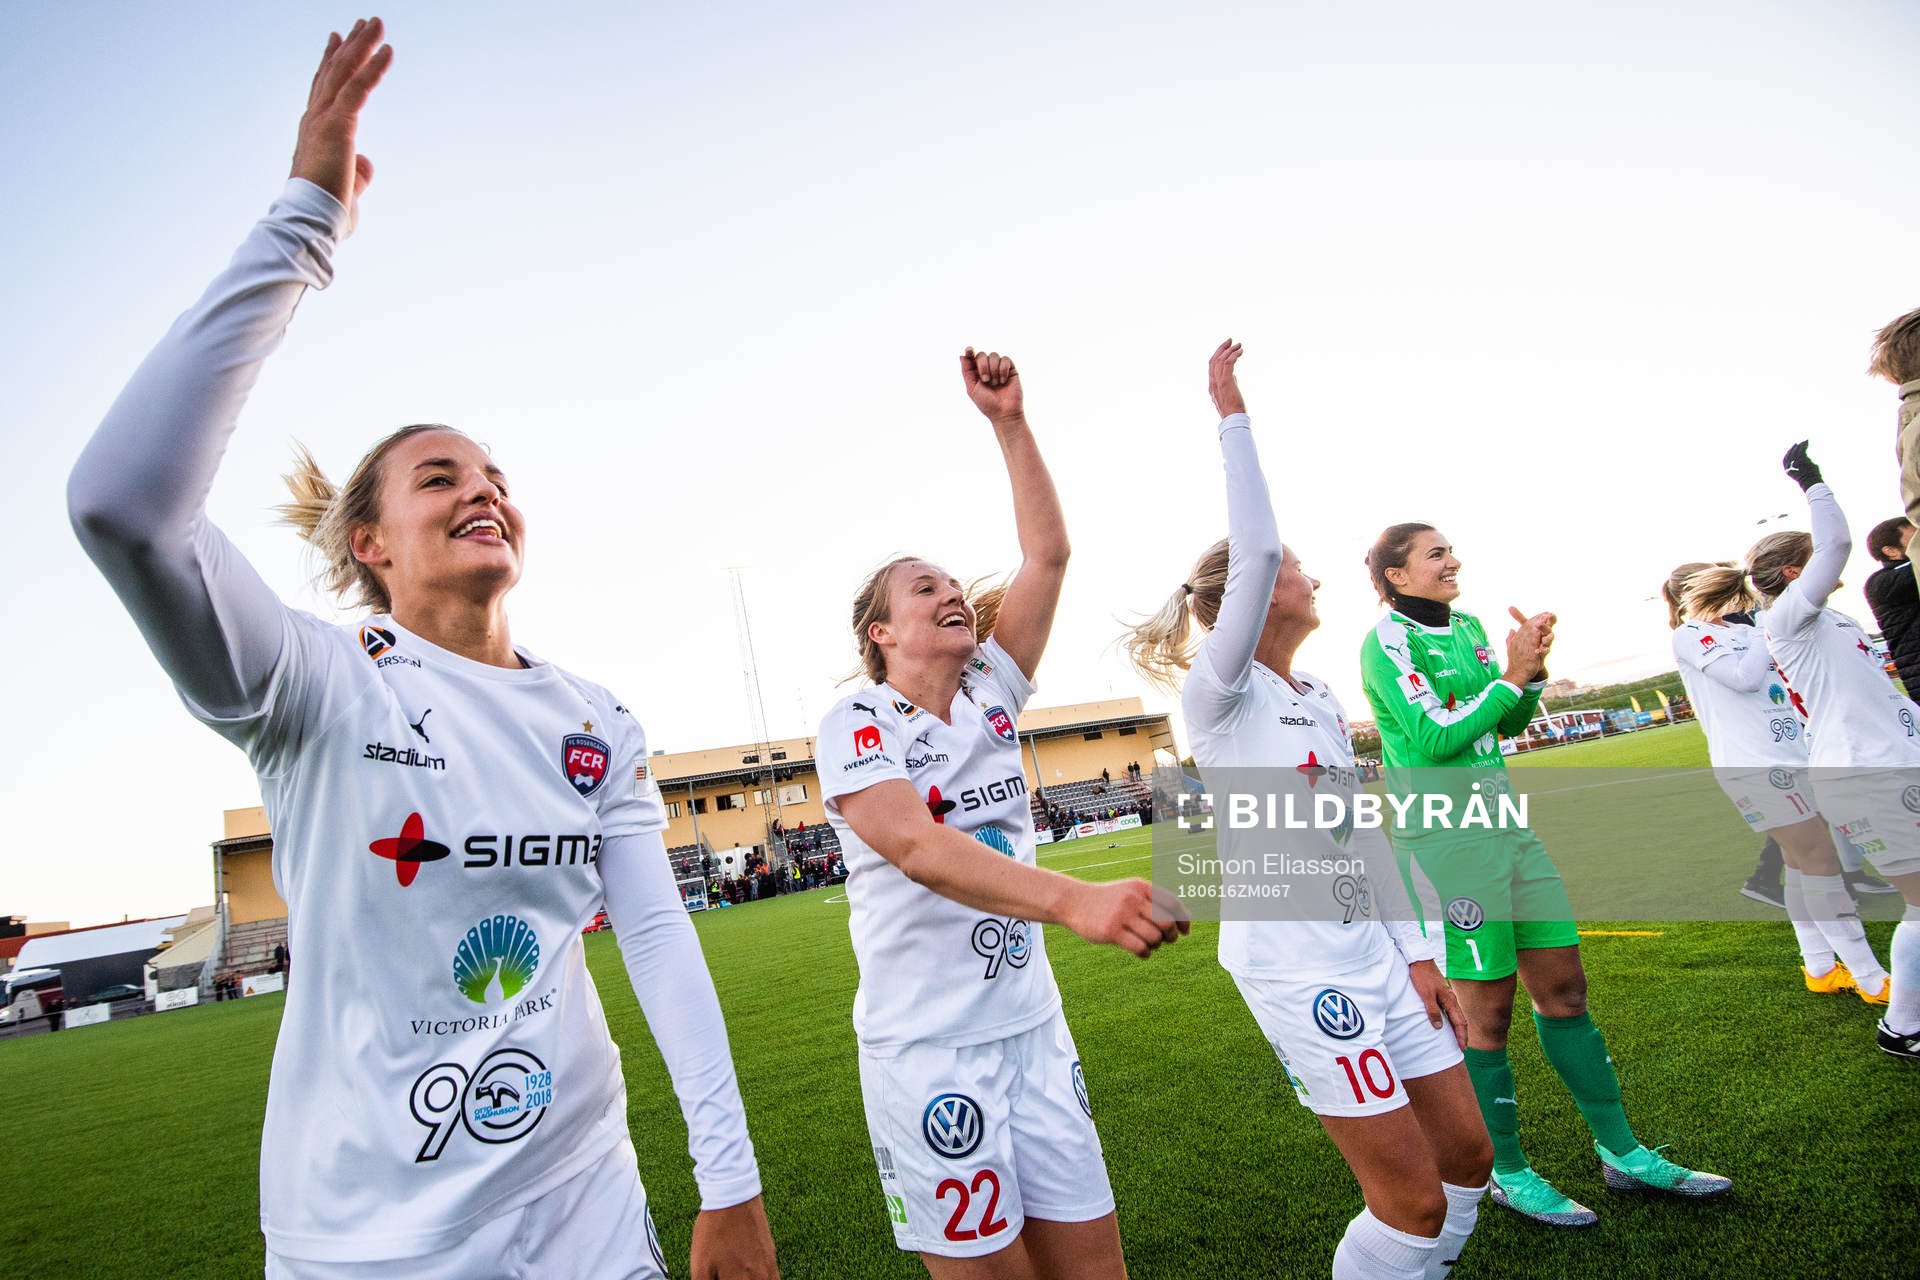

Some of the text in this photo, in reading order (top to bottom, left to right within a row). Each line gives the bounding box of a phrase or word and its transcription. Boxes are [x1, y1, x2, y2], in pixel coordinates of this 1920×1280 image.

[363, 742, 446, 770] stadium
[568, 749, 604, 769] FCR
[843, 753, 881, 772] SVENSKA
[905, 753, 949, 769] stadium
[1465, 938, 1483, 971] 1
[514, 994, 553, 1022] PARK
[525, 1071, 552, 1091] 1928
[1335, 1048, 1396, 1104] 10
[409, 1048, 548, 1163] 90
[526, 1088, 552, 1109] 2018
[935, 1168, 1008, 1242] 22
